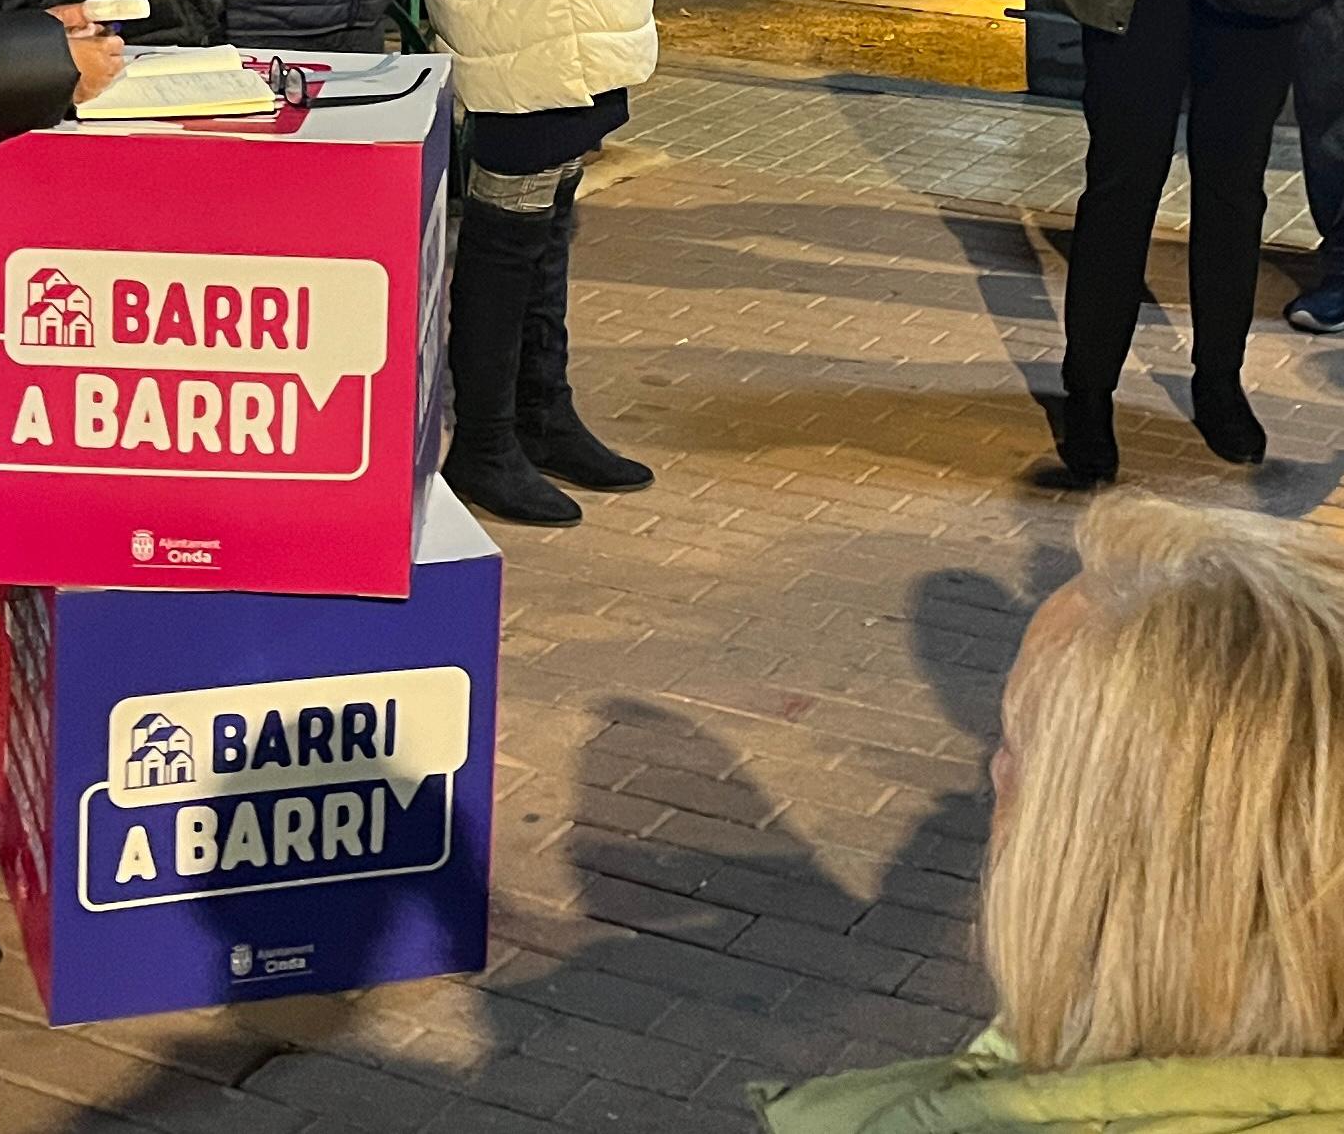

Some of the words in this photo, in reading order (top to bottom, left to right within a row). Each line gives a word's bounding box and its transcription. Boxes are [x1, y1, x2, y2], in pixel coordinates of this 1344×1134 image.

[112, 279, 310, 349] BARRI
[11, 385, 54, 446] A
[74, 373, 298, 455] BARRI
[167, 549, 212, 564] Onda
[213, 698, 396, 774] BARRI
[115, 825, 157, 884] A
[175, 787, 385, 877] BARRI
